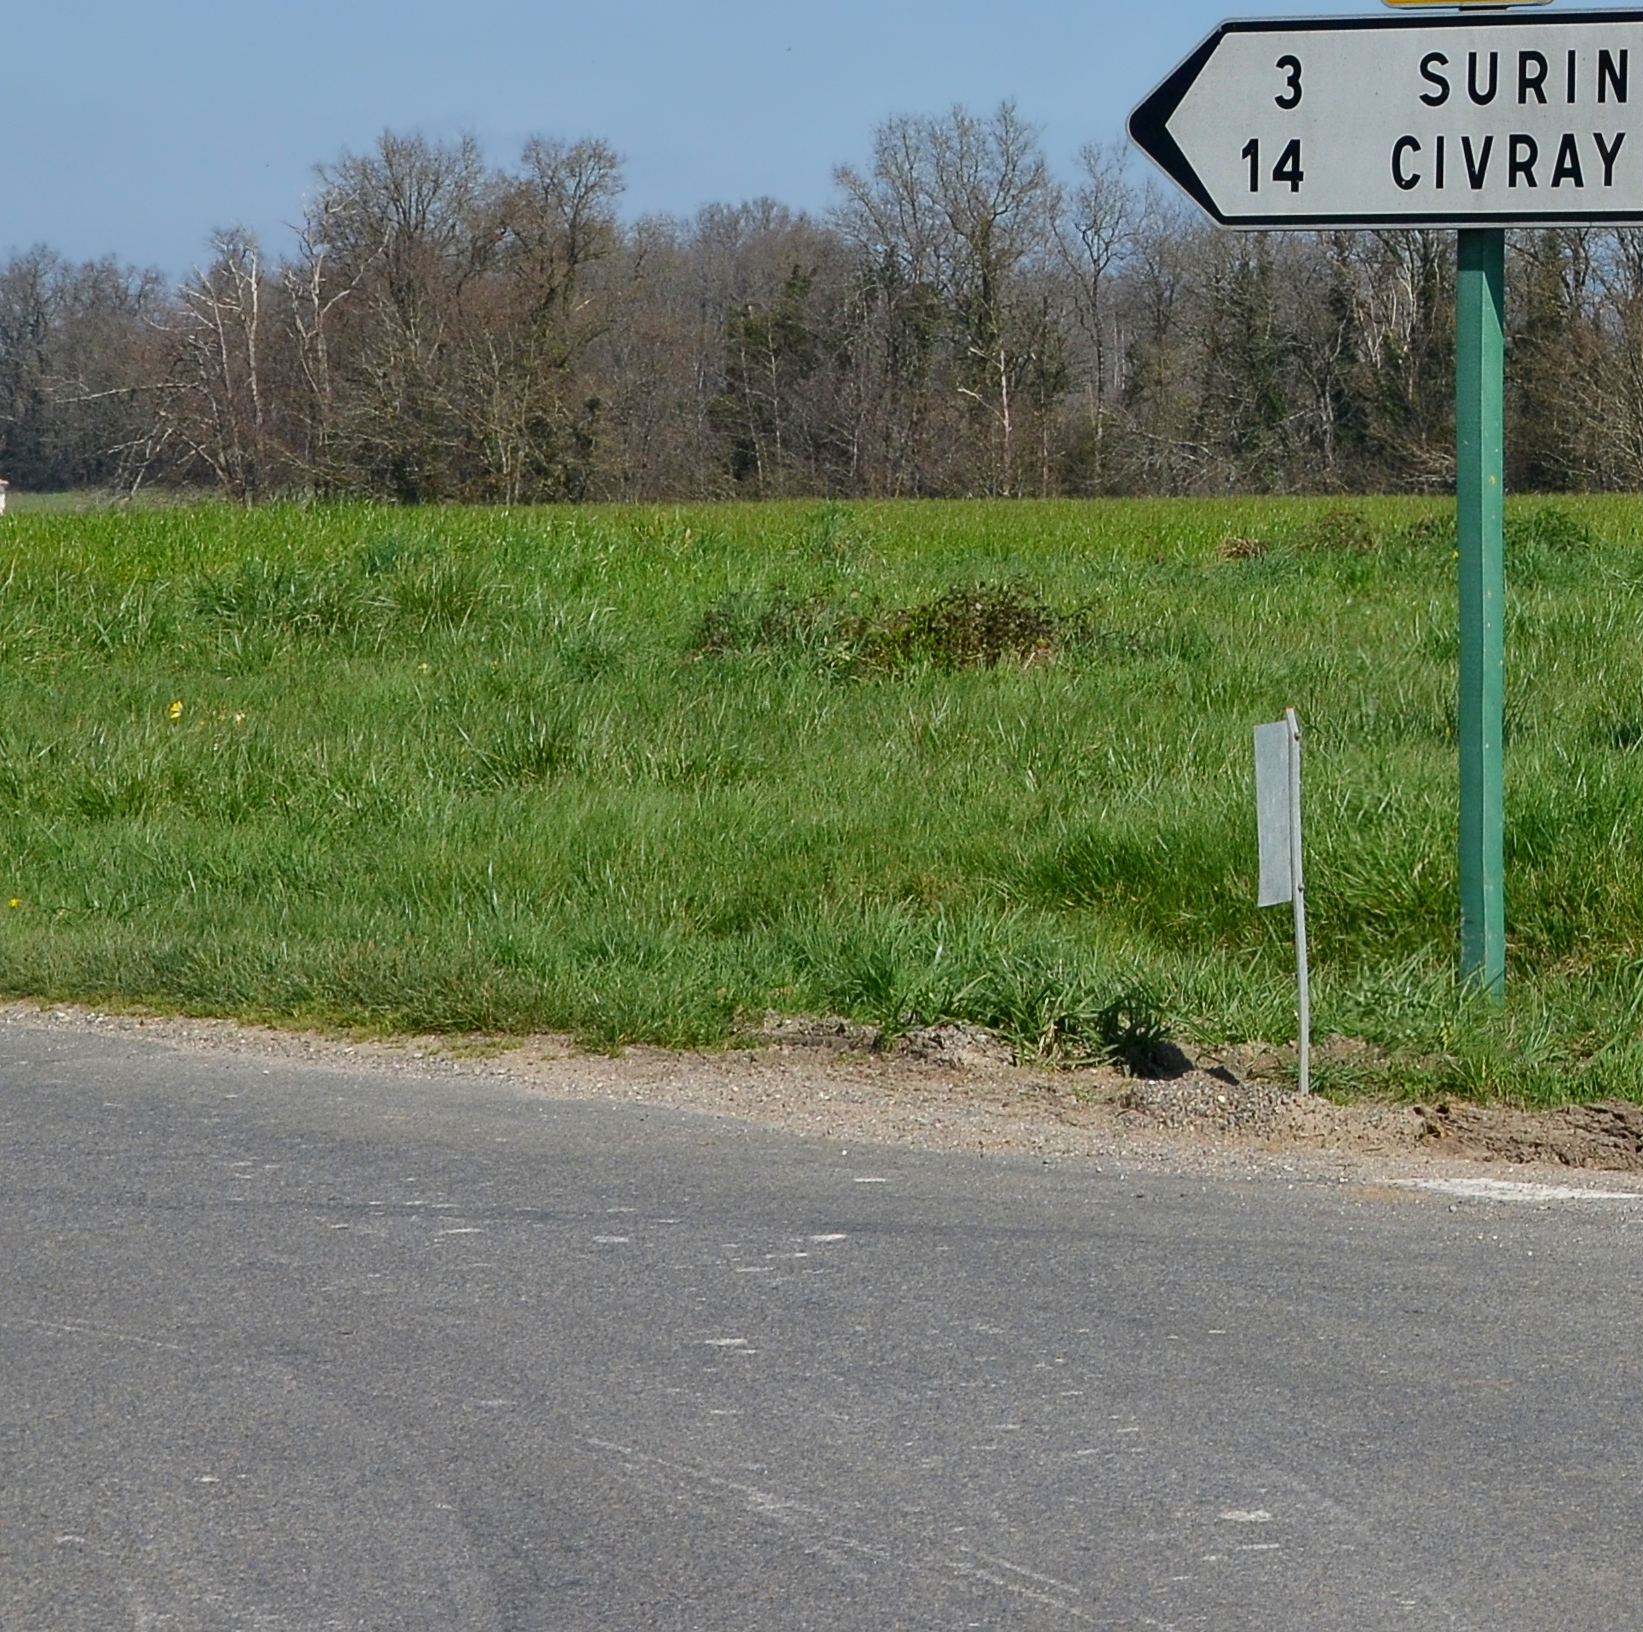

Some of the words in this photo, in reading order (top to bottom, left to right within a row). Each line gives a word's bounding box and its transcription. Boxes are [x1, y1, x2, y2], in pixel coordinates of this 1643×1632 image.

[1274, 54, 1303, 110] 3
[1419, 48, 1629, 107] SURIN
[1241, 138, 1304, 193] 14
[1391, 132, 1626, 191] CIVRAY
